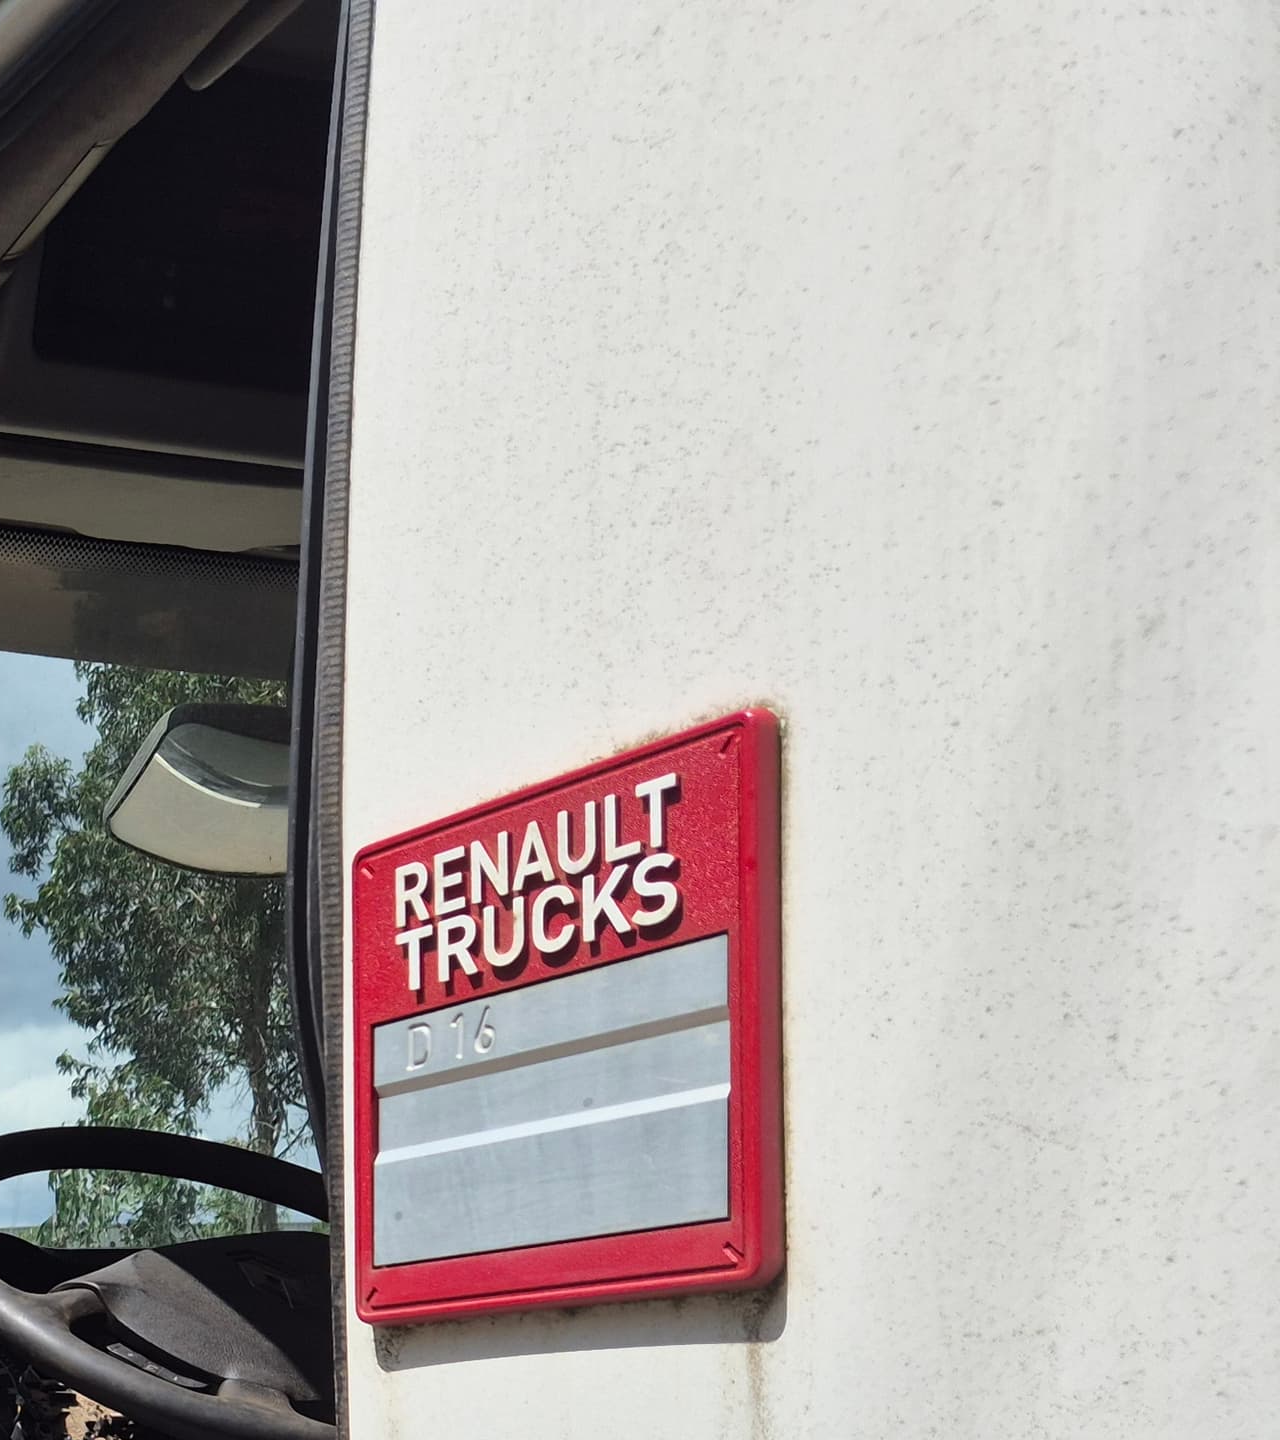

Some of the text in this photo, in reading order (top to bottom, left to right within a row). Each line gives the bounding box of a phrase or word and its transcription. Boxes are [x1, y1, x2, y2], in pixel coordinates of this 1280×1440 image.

[394, 773, 678, 929] RENAULT
[395, 852, 679, 992] TRUCKS
[405, 1005, 496, 1072] D 16
